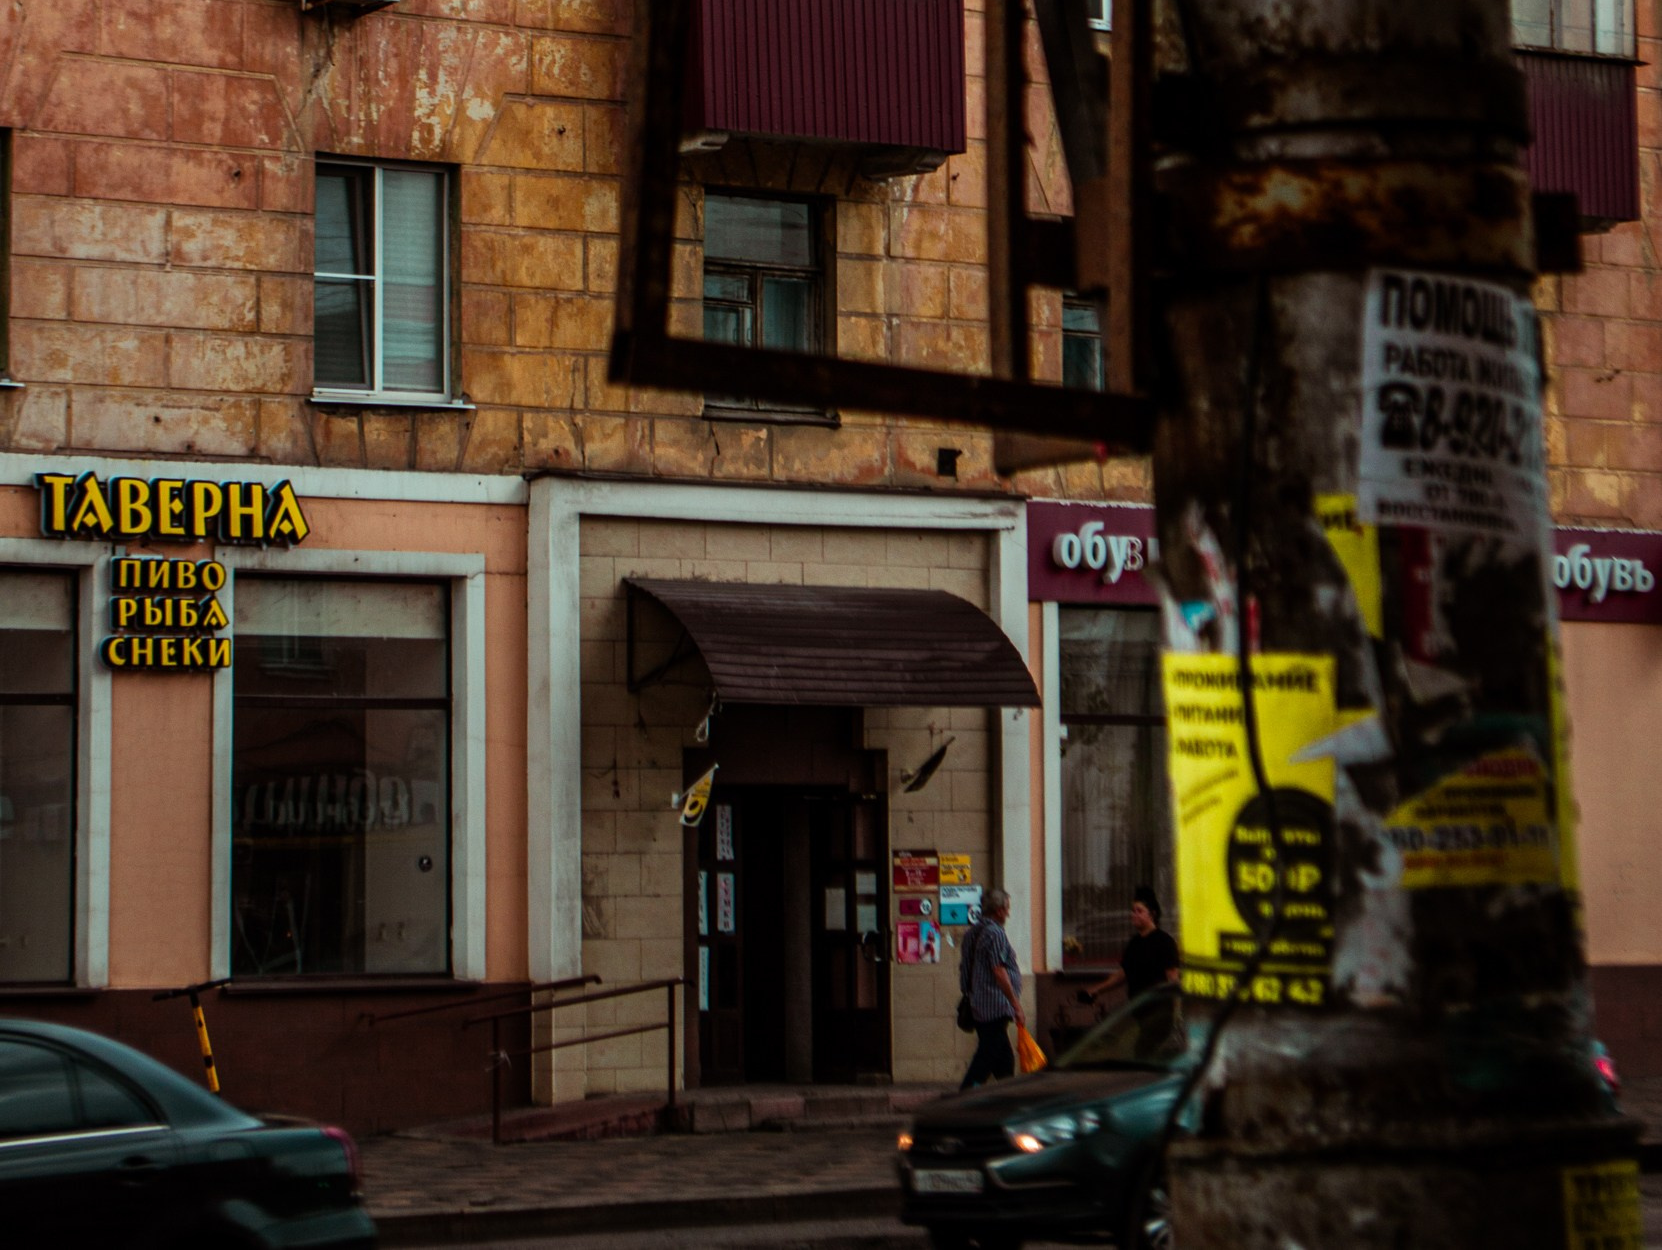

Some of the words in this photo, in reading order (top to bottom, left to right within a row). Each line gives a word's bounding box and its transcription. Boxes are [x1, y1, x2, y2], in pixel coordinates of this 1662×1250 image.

[1384, 342, 1473, 382] РАБОТА
[42, 472, 311, 542] ТАВЕРНА
[117, 558, 227, 592] ПИВО
[1554, 543, 1656, 604] обувь
[117, 597, 230, 629] РЫБА
[107, 636, 232, 668] СНЕКИ
